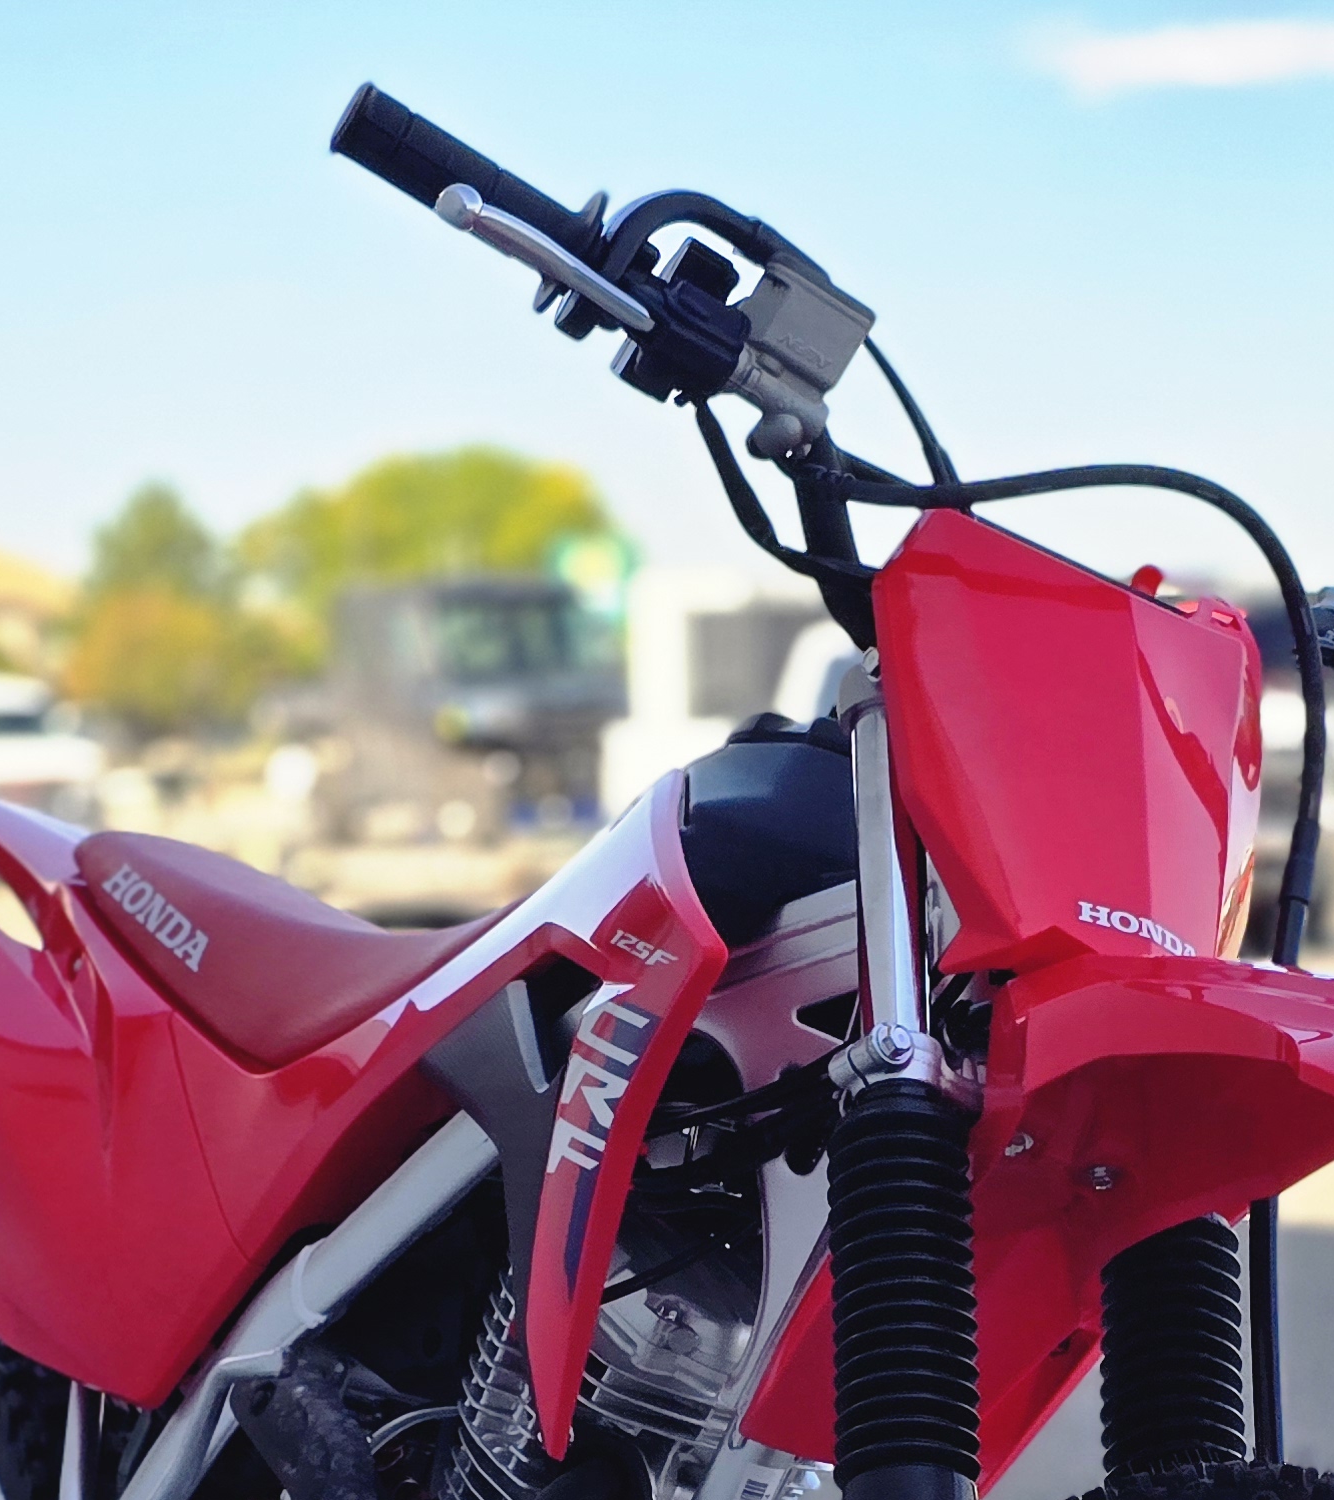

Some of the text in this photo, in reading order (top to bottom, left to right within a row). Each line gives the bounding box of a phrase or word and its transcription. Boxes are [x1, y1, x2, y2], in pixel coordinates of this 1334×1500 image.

[101, 863, 208, 973] HONDA
[610, 930, 679, 965] 125F
[1078, 901, 1196, 957] HONDA
[546, 1001, 650, 1174] CRF
